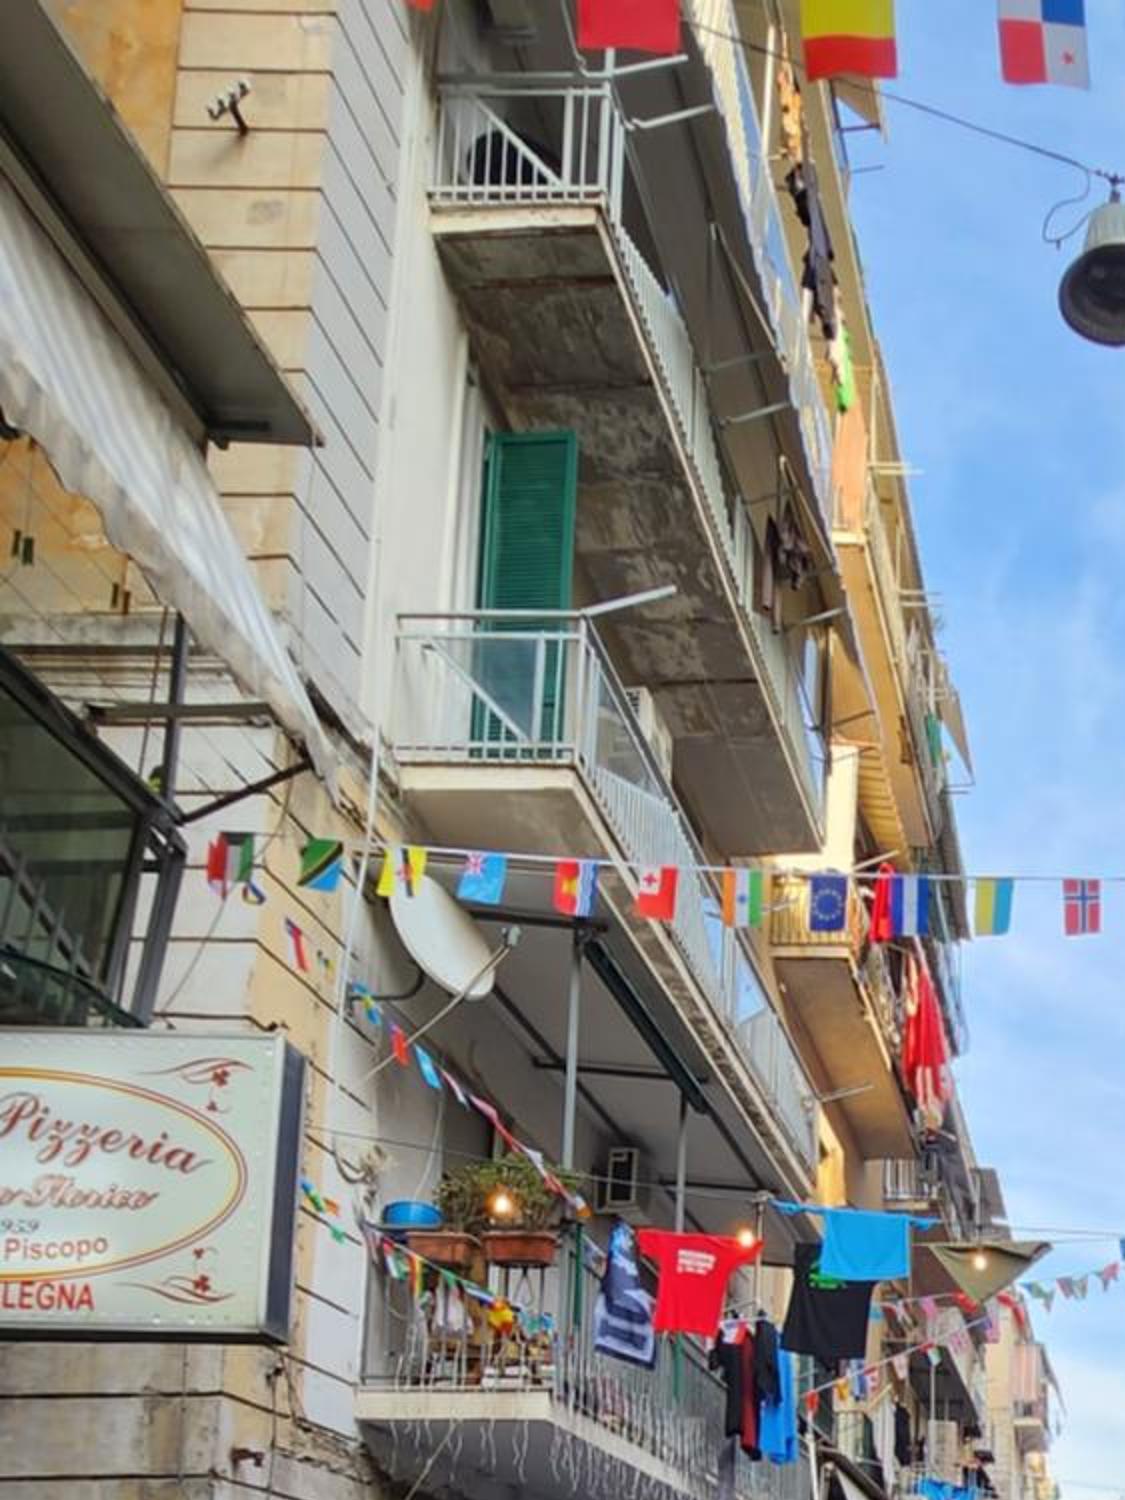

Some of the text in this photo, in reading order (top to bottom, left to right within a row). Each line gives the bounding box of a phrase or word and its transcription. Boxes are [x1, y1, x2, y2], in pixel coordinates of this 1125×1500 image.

[0, 1091, 214, 1174] Pizzeria
[5, 1237, 108, 1263] Piscopo
[0, 1280, 95, 1311] LEGNA
